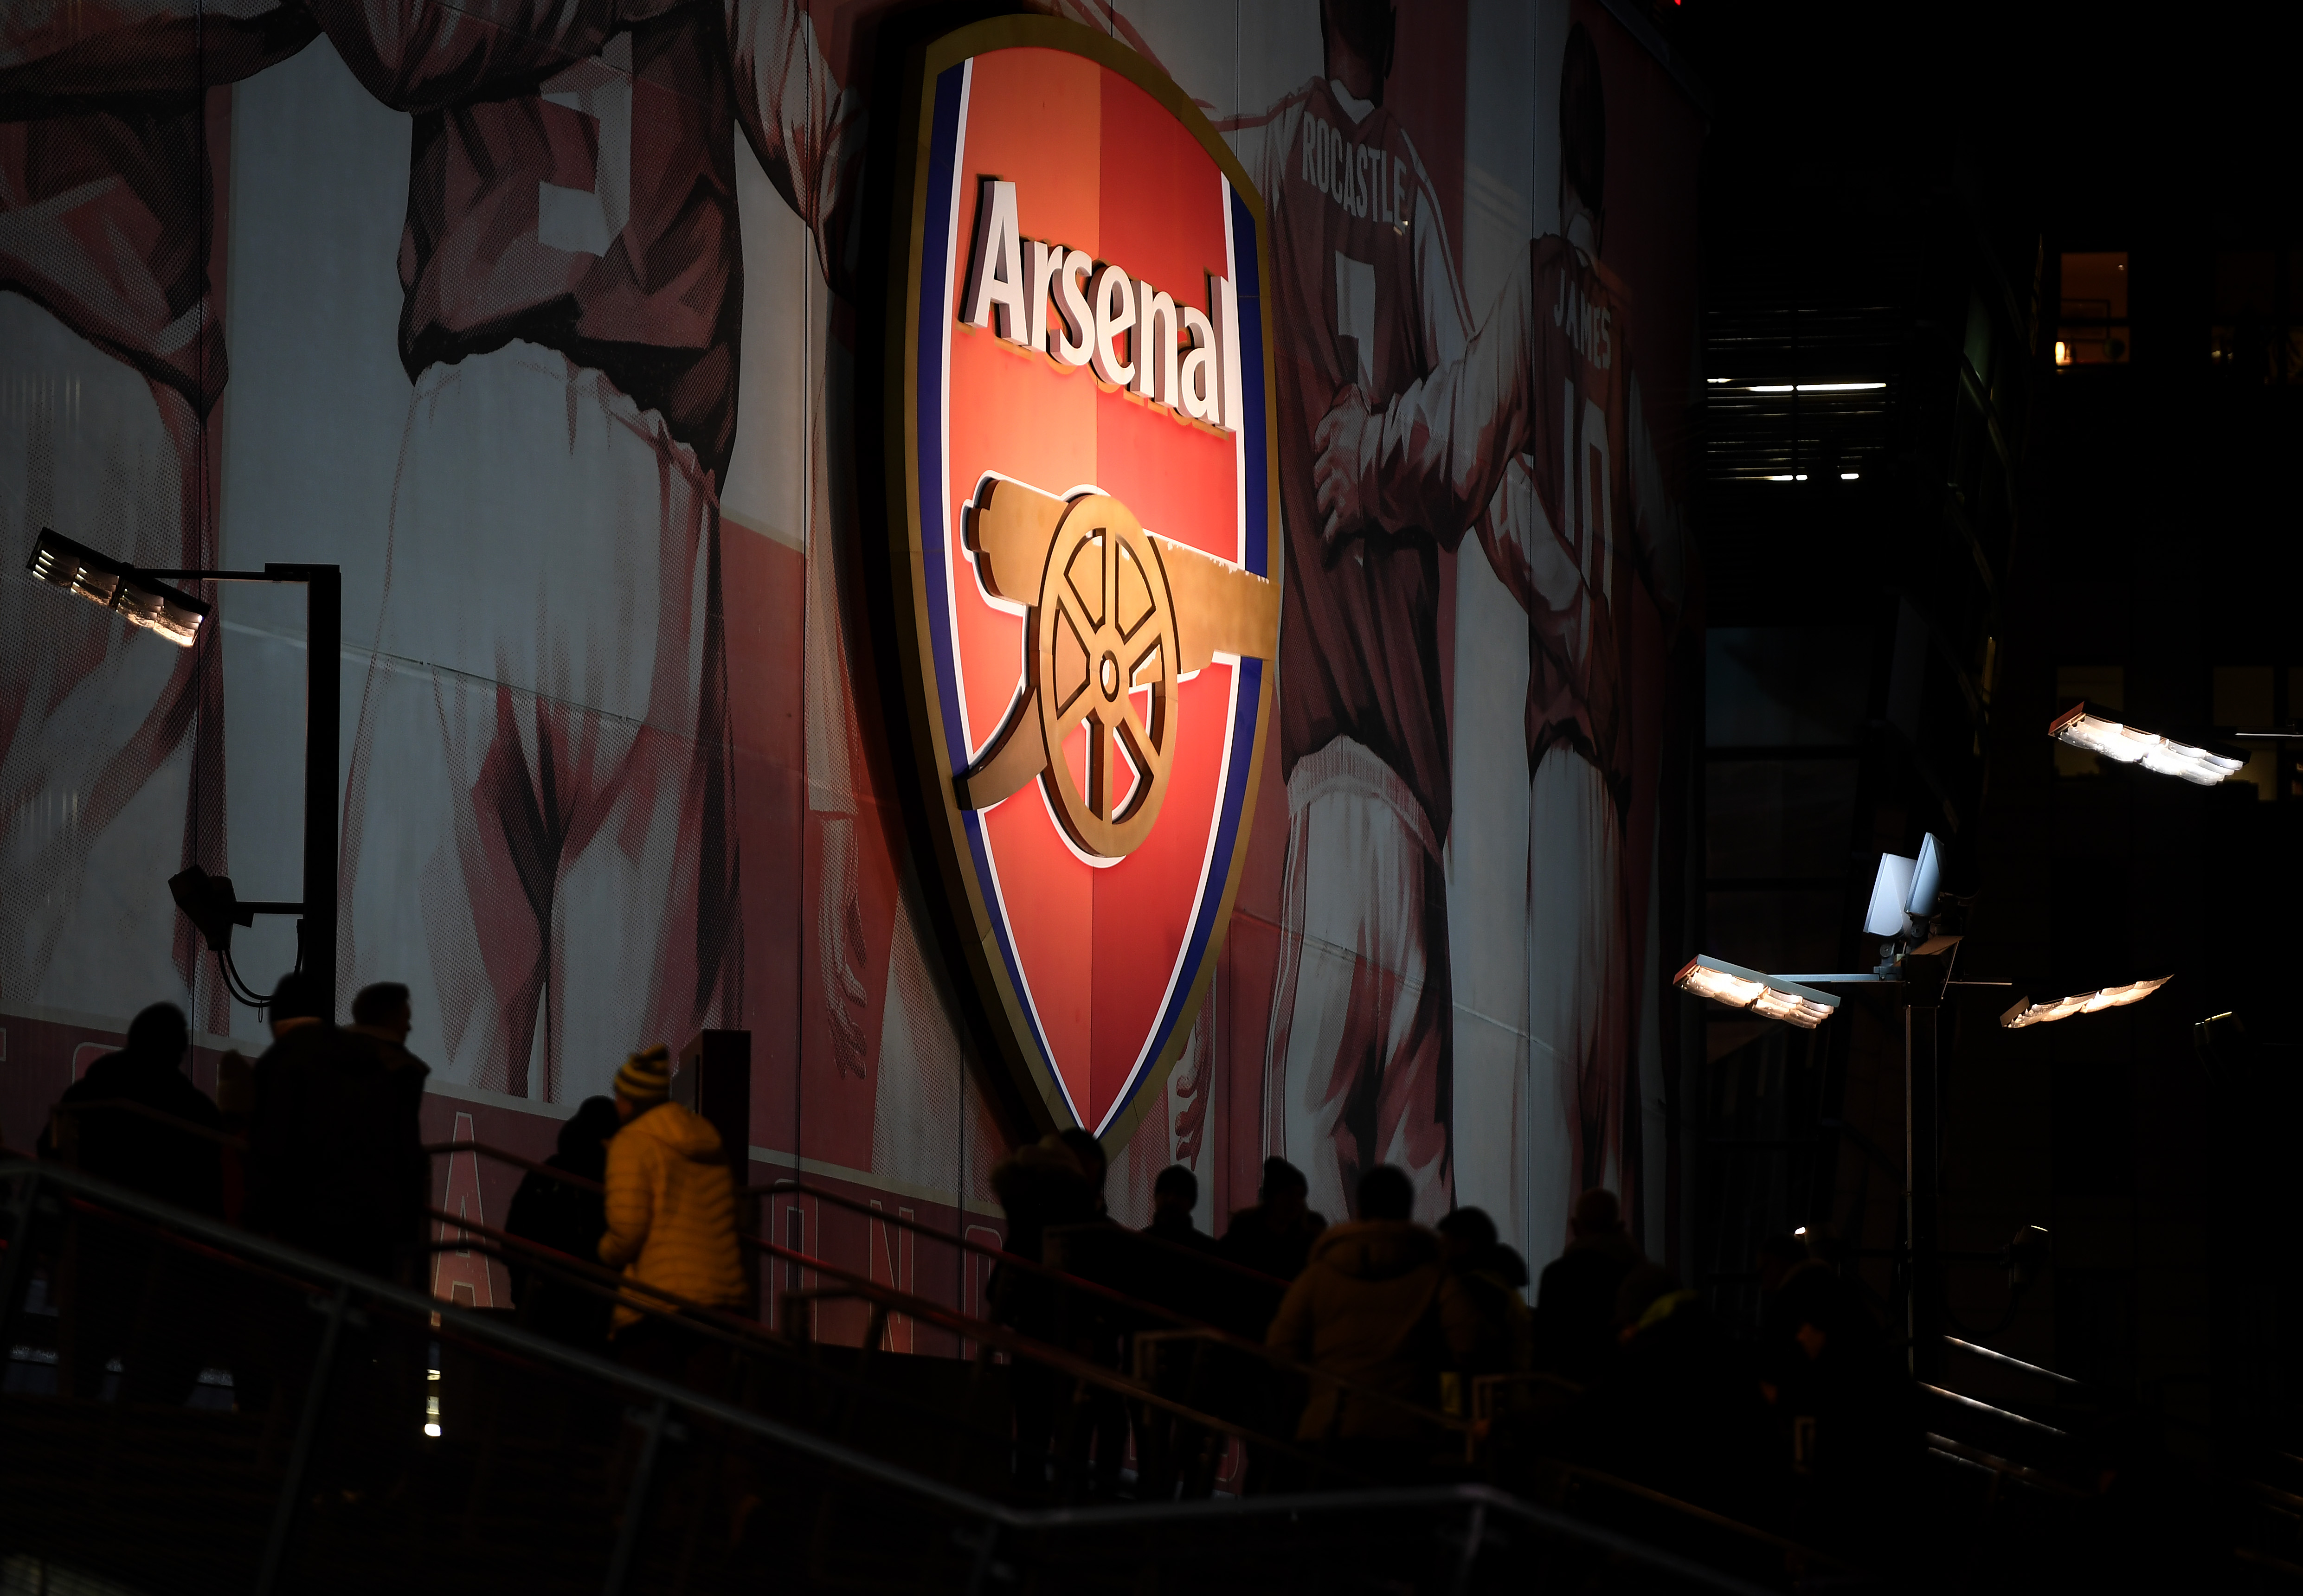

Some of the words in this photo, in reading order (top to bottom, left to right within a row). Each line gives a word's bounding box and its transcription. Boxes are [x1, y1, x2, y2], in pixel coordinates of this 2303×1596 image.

[1302, 111, 1407, 234] ROCASTLE
[963, 180, 1238, 432] Arsenal
[1554, 267, 1611, 370] JAMES
